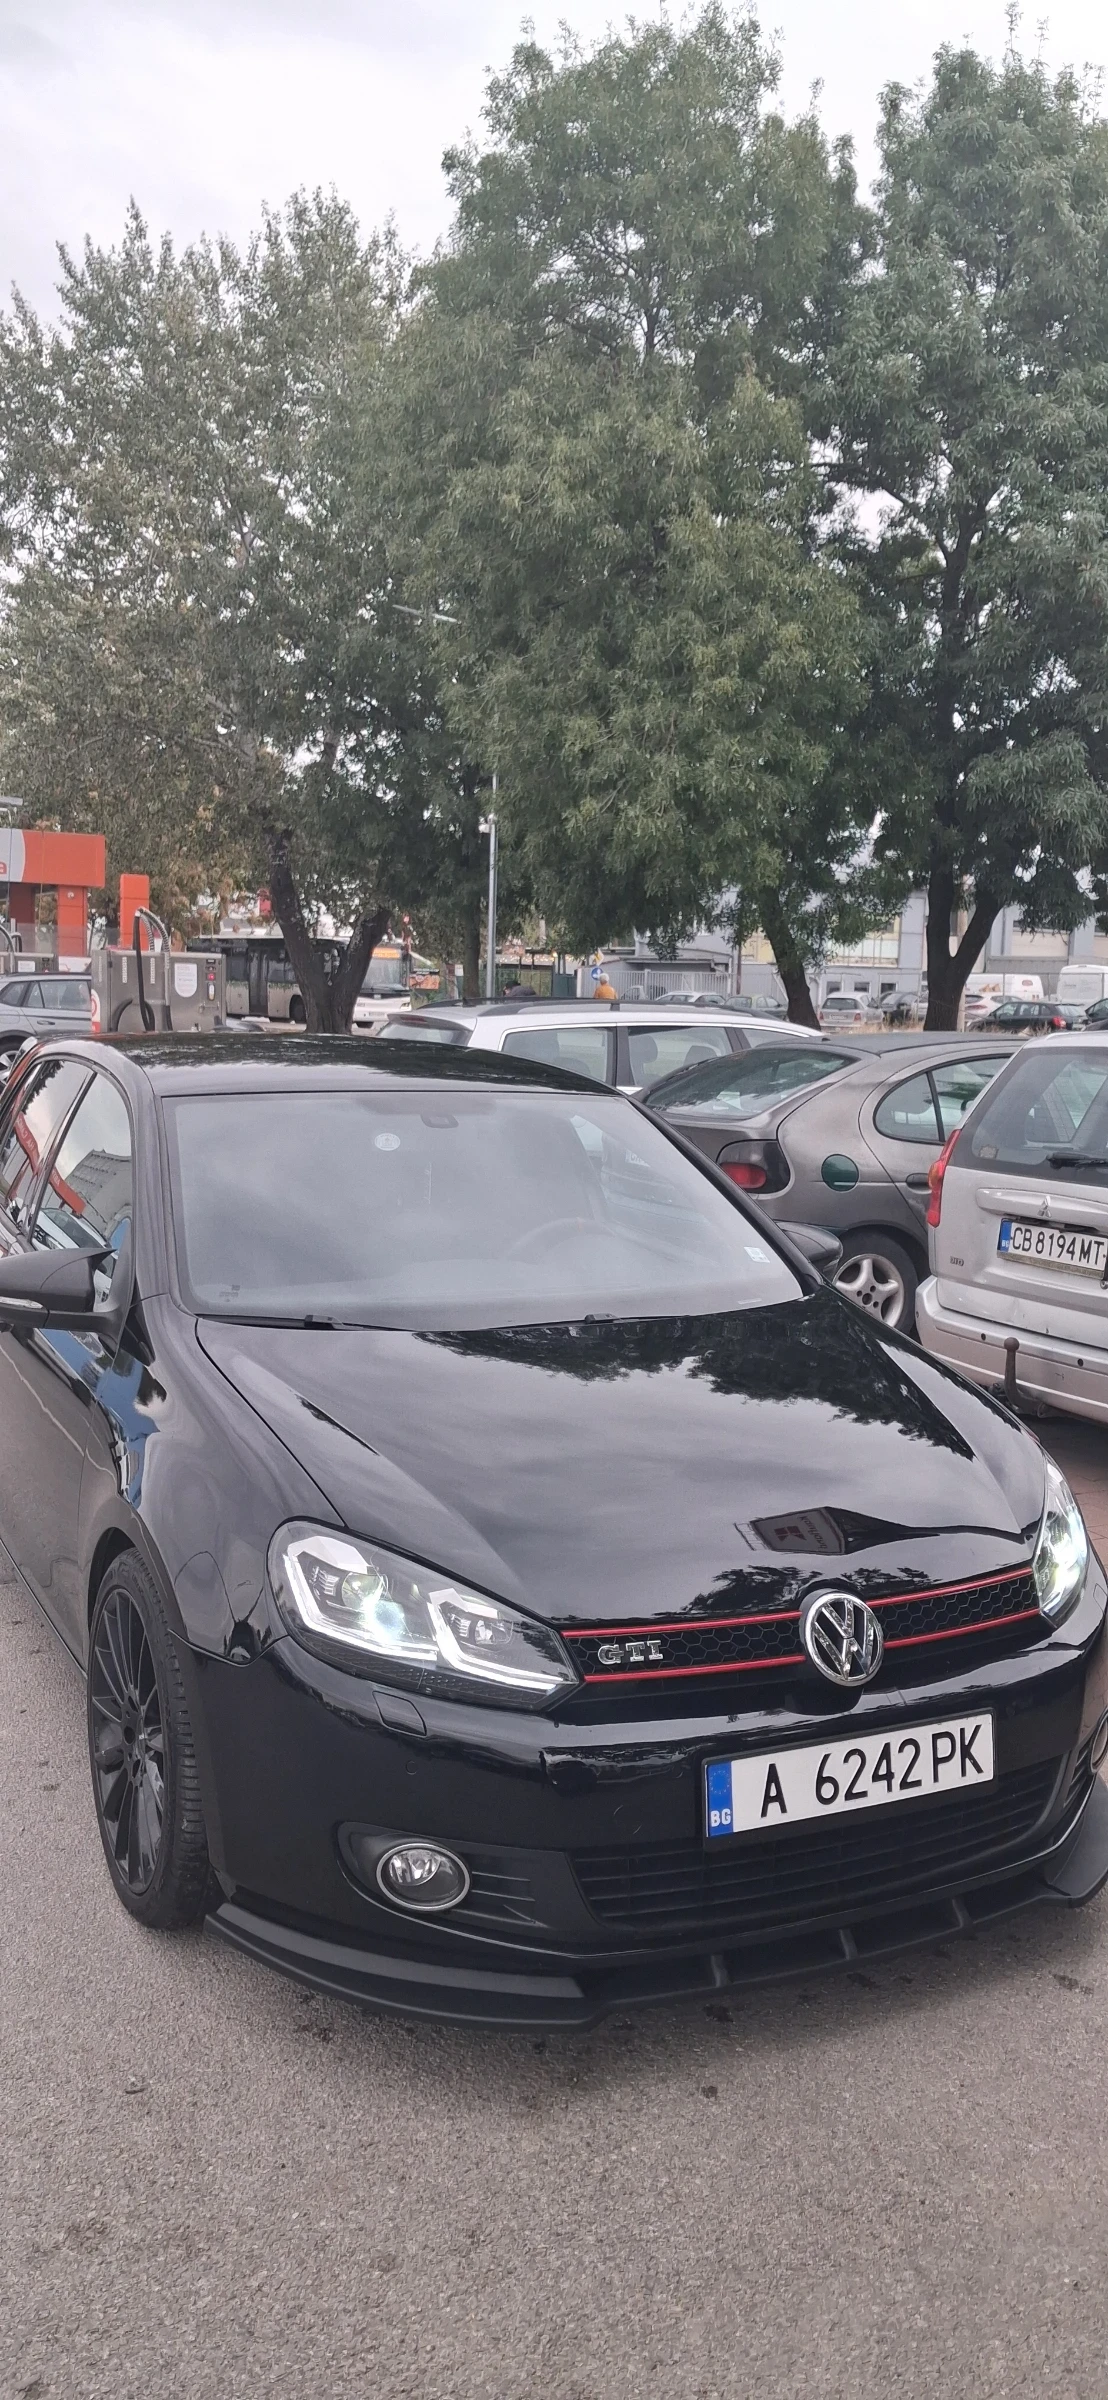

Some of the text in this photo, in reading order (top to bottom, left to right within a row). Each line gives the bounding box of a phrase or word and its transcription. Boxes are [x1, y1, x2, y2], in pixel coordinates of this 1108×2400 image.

[597, 1640, 664, 1665] GTI
[760, 1763, 788, 1818] A
[710, 1808, 732, 1827] BG
